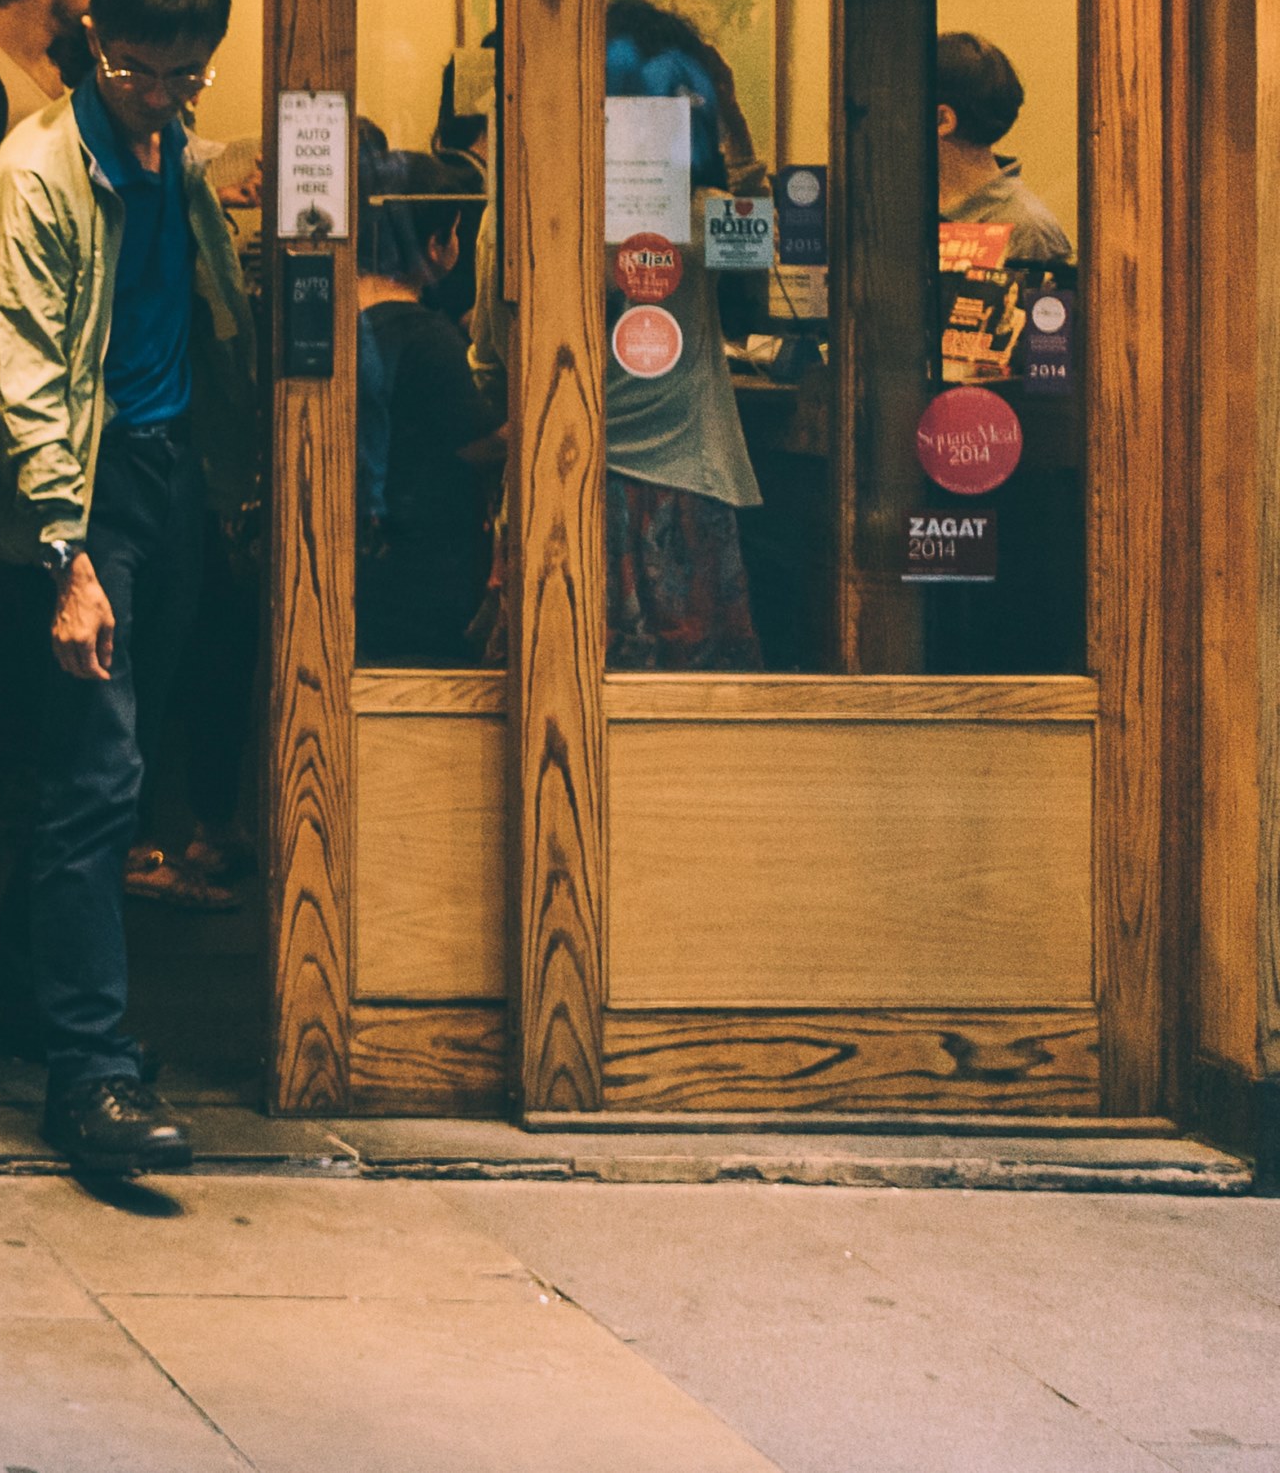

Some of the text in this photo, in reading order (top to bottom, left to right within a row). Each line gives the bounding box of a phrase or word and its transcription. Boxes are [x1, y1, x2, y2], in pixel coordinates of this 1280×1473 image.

[296, 128, 330, 141] AUTO
[295, 145, 330, 157] DOOR
[293, 164, 333, 178] PRESS
[296, 182, 329, 194] HERE
[785, 238, 821, 251] 2015
[294, 277, 329, 288] AUTO
[1030, 364, 1067, 378] 2014
[949, 445, 991, 466] 2014
[909, 516, 988, 538] ZAGAT
[908, 538, 957, 560] 2014
